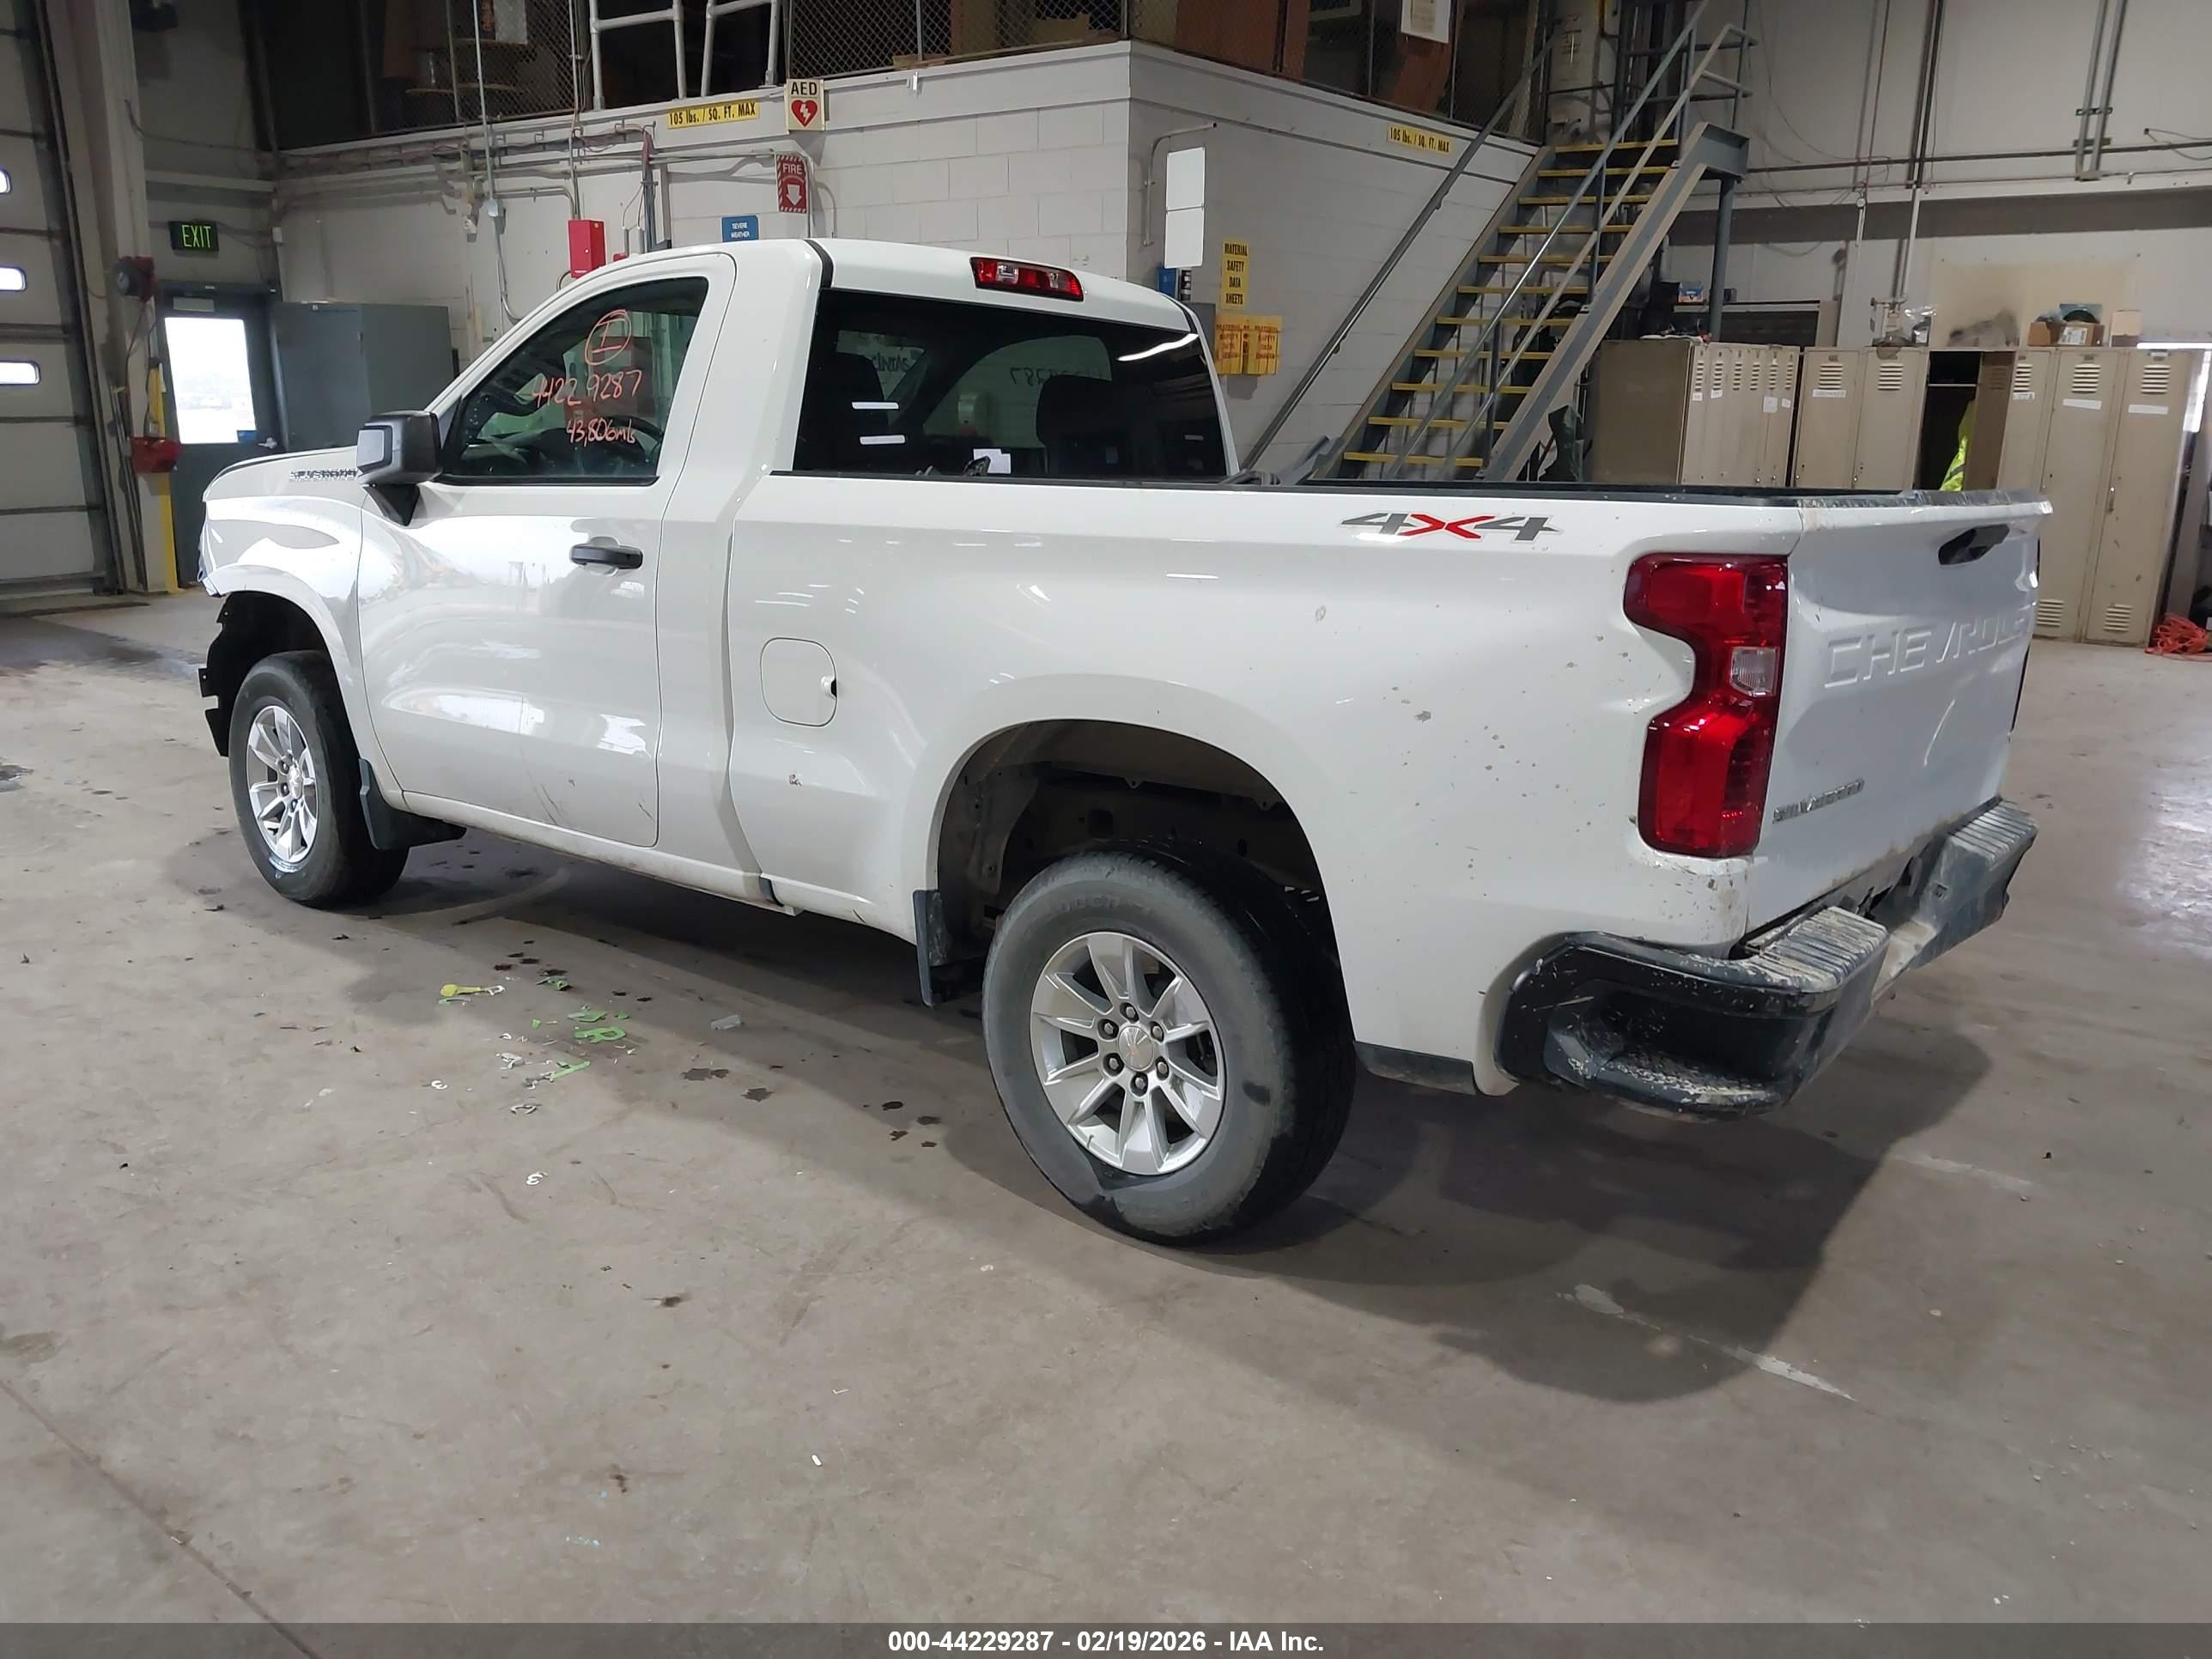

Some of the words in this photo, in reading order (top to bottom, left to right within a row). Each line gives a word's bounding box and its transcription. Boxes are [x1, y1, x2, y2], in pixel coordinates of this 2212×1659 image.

[790, 82, 817, 95] AED
[669, 112, 684, 126] 105
[686, 109, 700, 124] lbs.
[708, 108, 721, 120] SQ.
[724, 106, 735, 118] FT.
[738, 102, 756, 116] MAX
[1390, 127, 1401, 141] 105
[1437, 139, 1449, 152] MAX
[782, 163, 803, 174] FIRE
[181, 224, 211, 248] EXIT
[1224, 242, 1248, 257] MATERIAL
[1226, 259, 1244, 272] SAFETY
[1229, 276, 1242, 288] DATA
[1225, 293, 1243, 305] SHEETS
[586, 369, 642, 402] 9287
